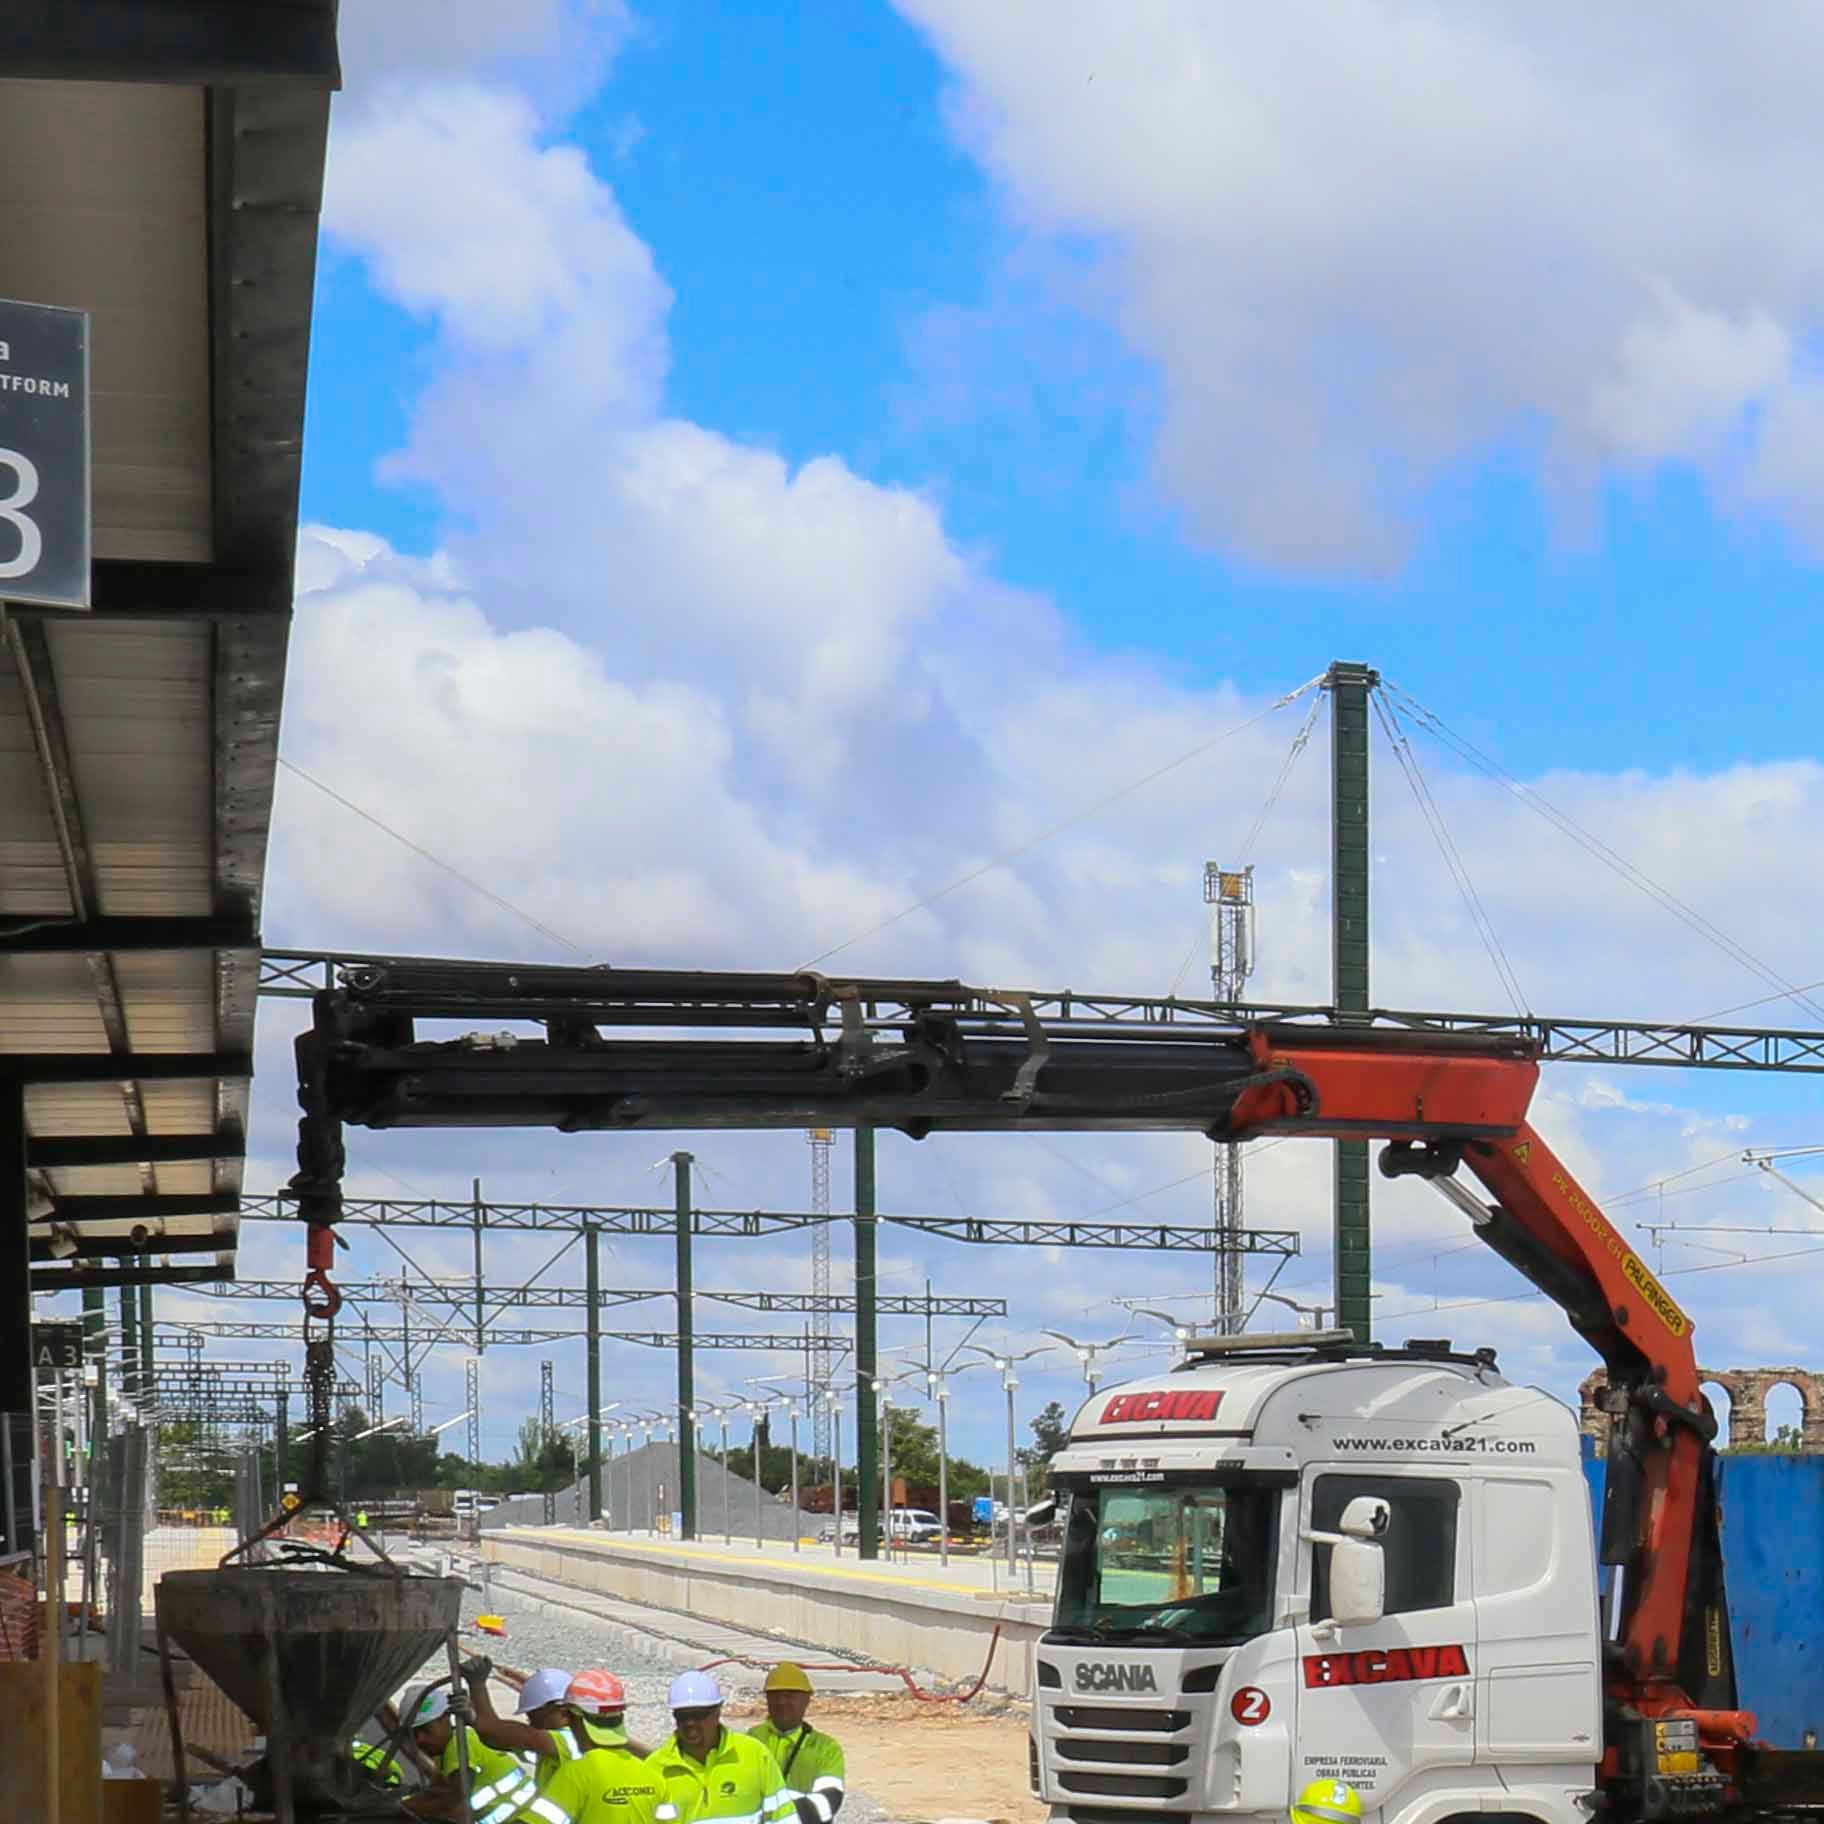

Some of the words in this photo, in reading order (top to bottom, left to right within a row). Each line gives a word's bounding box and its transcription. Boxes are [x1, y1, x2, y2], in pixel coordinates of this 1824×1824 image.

[1099, 1390, 1226, 1425] EXCAVA
[1332, 1437, 1536, 1453] www.excava21.com
[1075, 1662, 1158, 1692] SCANIA
[1302, 1645, 1471, 1689] EXCAVA
[1241, 1691, 1265, 1719] 2
[1315, 1768, 1340, 1778] OBRAS
